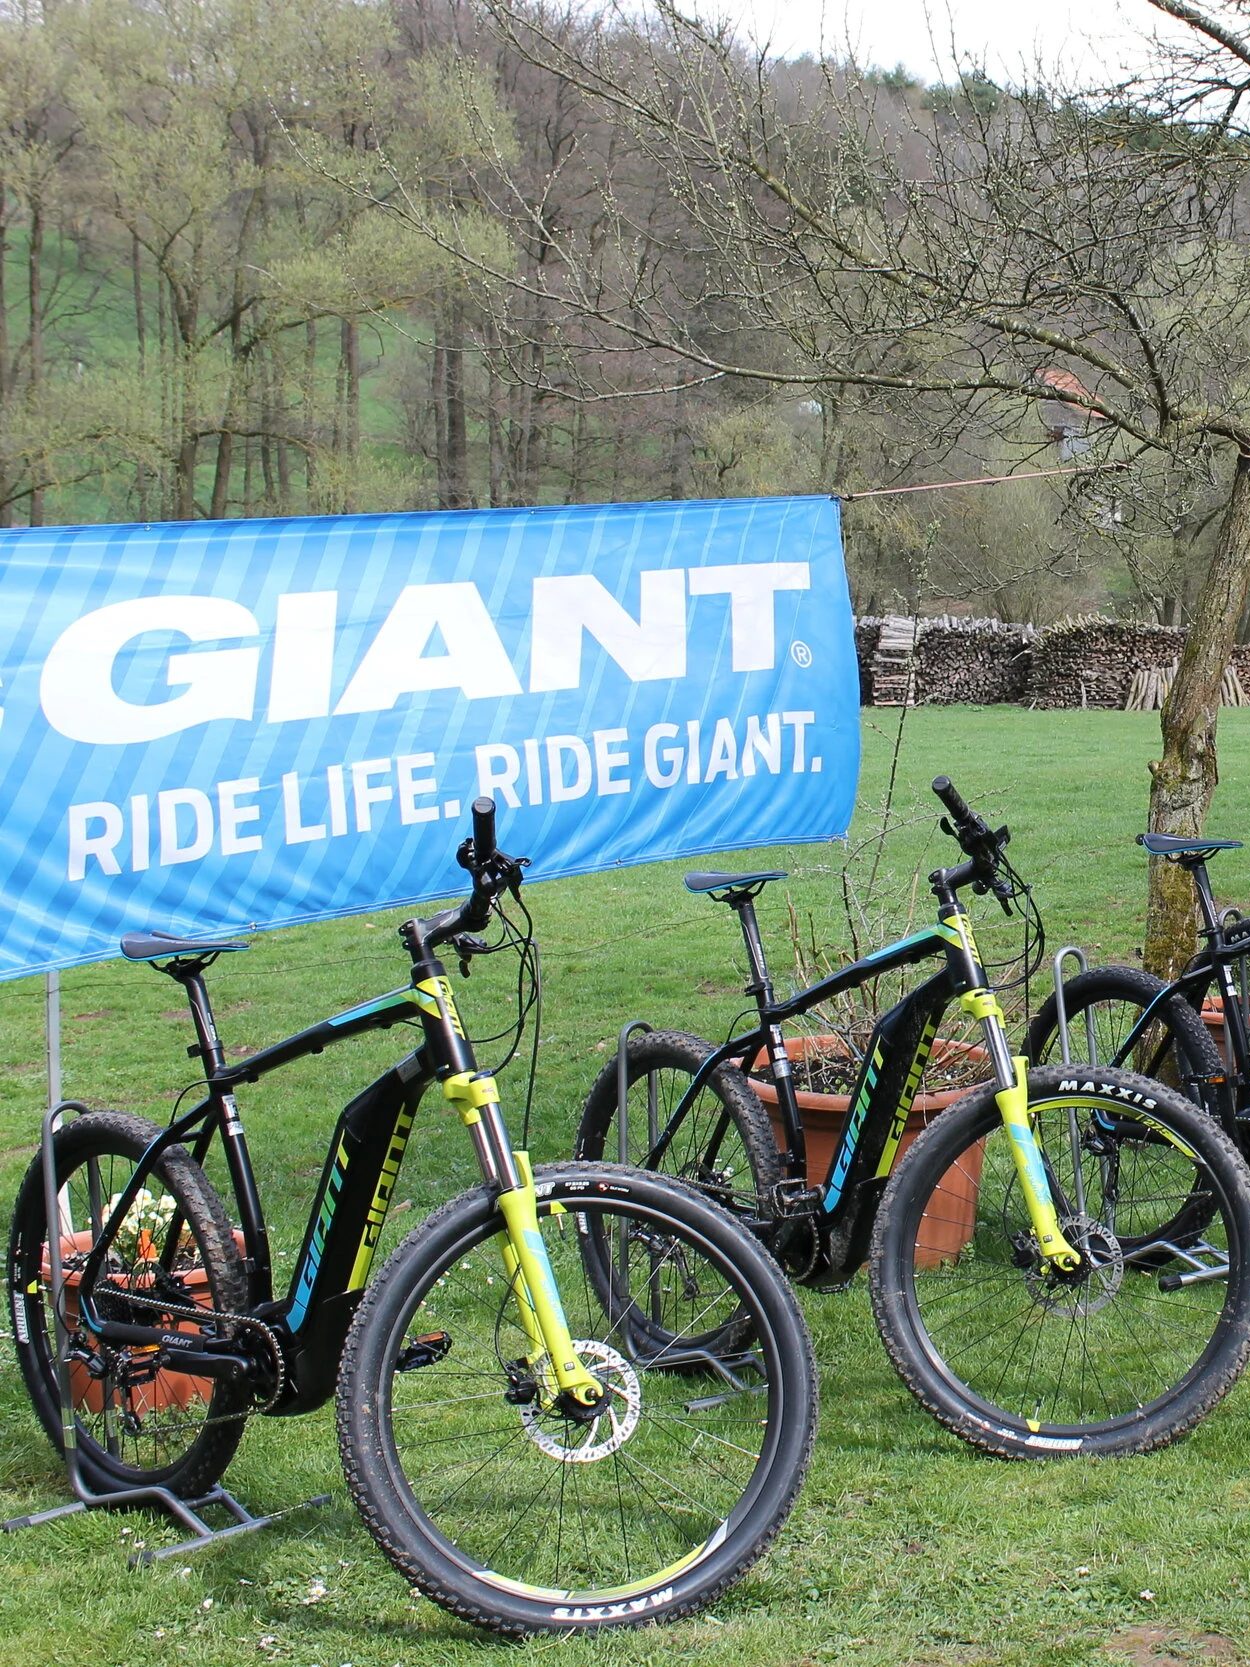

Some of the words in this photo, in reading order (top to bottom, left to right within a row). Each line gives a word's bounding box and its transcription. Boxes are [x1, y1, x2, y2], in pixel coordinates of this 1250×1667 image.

[40, 562, 812, 745] GIANT
[68, 778, 263, 882] RIDE
[282, 750, 461, 847] LIFE.
[475, 727, 631, 809] RIDE
[643, 708, 822, 788] GIANT.
[831, 1034, 884, 1193] GIANT
[1058, 1079, 1158, 1110] MAXXIS
[294, 1128, 351, 1311] GIANT
[12, 1289, 30, 1345] ARDENT
[161, 1334, 193, 1348] GIANT
[550, 1586, 674, 1621] MAXXIS
